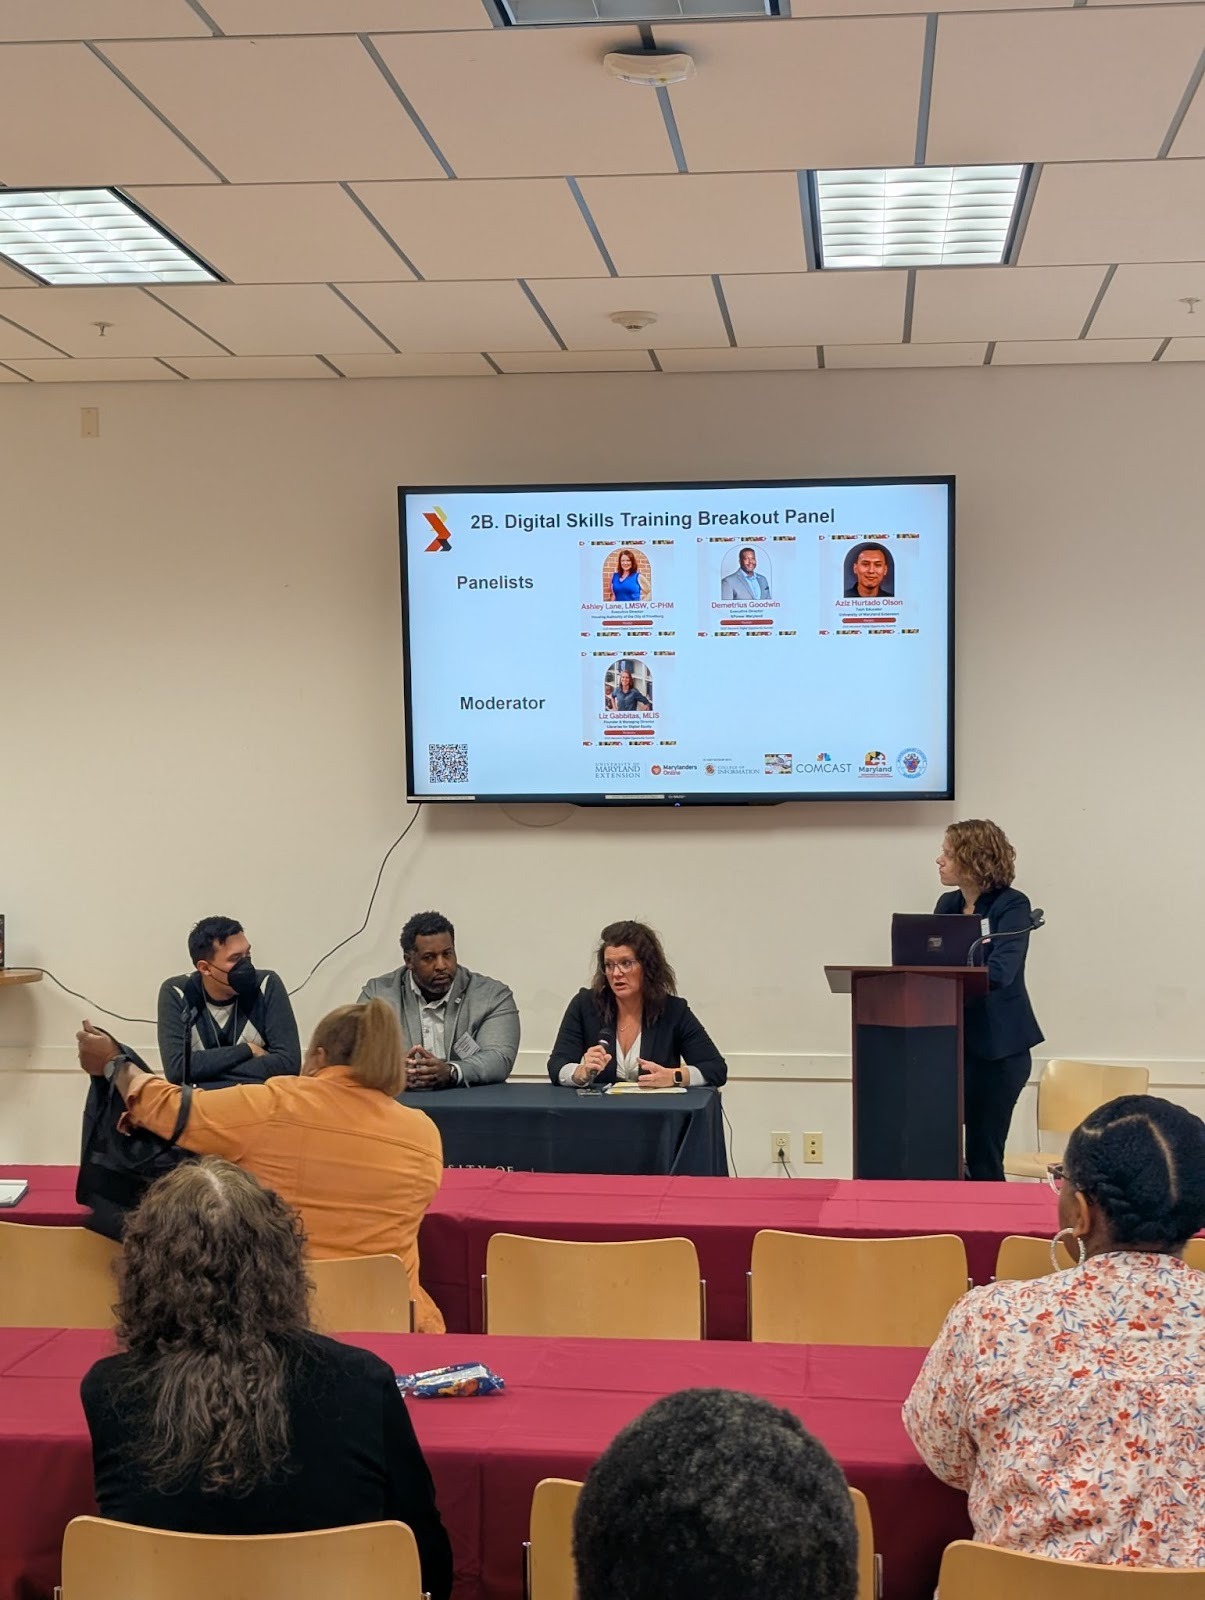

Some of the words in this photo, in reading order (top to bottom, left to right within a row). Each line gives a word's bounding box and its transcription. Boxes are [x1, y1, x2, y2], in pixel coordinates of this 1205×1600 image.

[470, 514, 499, 529] 2B.
[504, 514, 560, 532] Digital
[566, 513, 614, 528] Skills
[620, 511, 692, 530] Training
[698, 510, 779, 526] Breakout
[785, 508, 835, 524] Panel
[457, 575, 534, 590] Panelists
[581, 603, 603, 611] Ashley
[605, 602, 623, 610] Lane,
[625, 602, 649, 610] LMSW,
[882, 598, 903, 606] Olson
[460, 696, 545, 710] Moderator
[796, 764, 852, 773] COMCAST
[858, 766, 892, 775] Maryland
